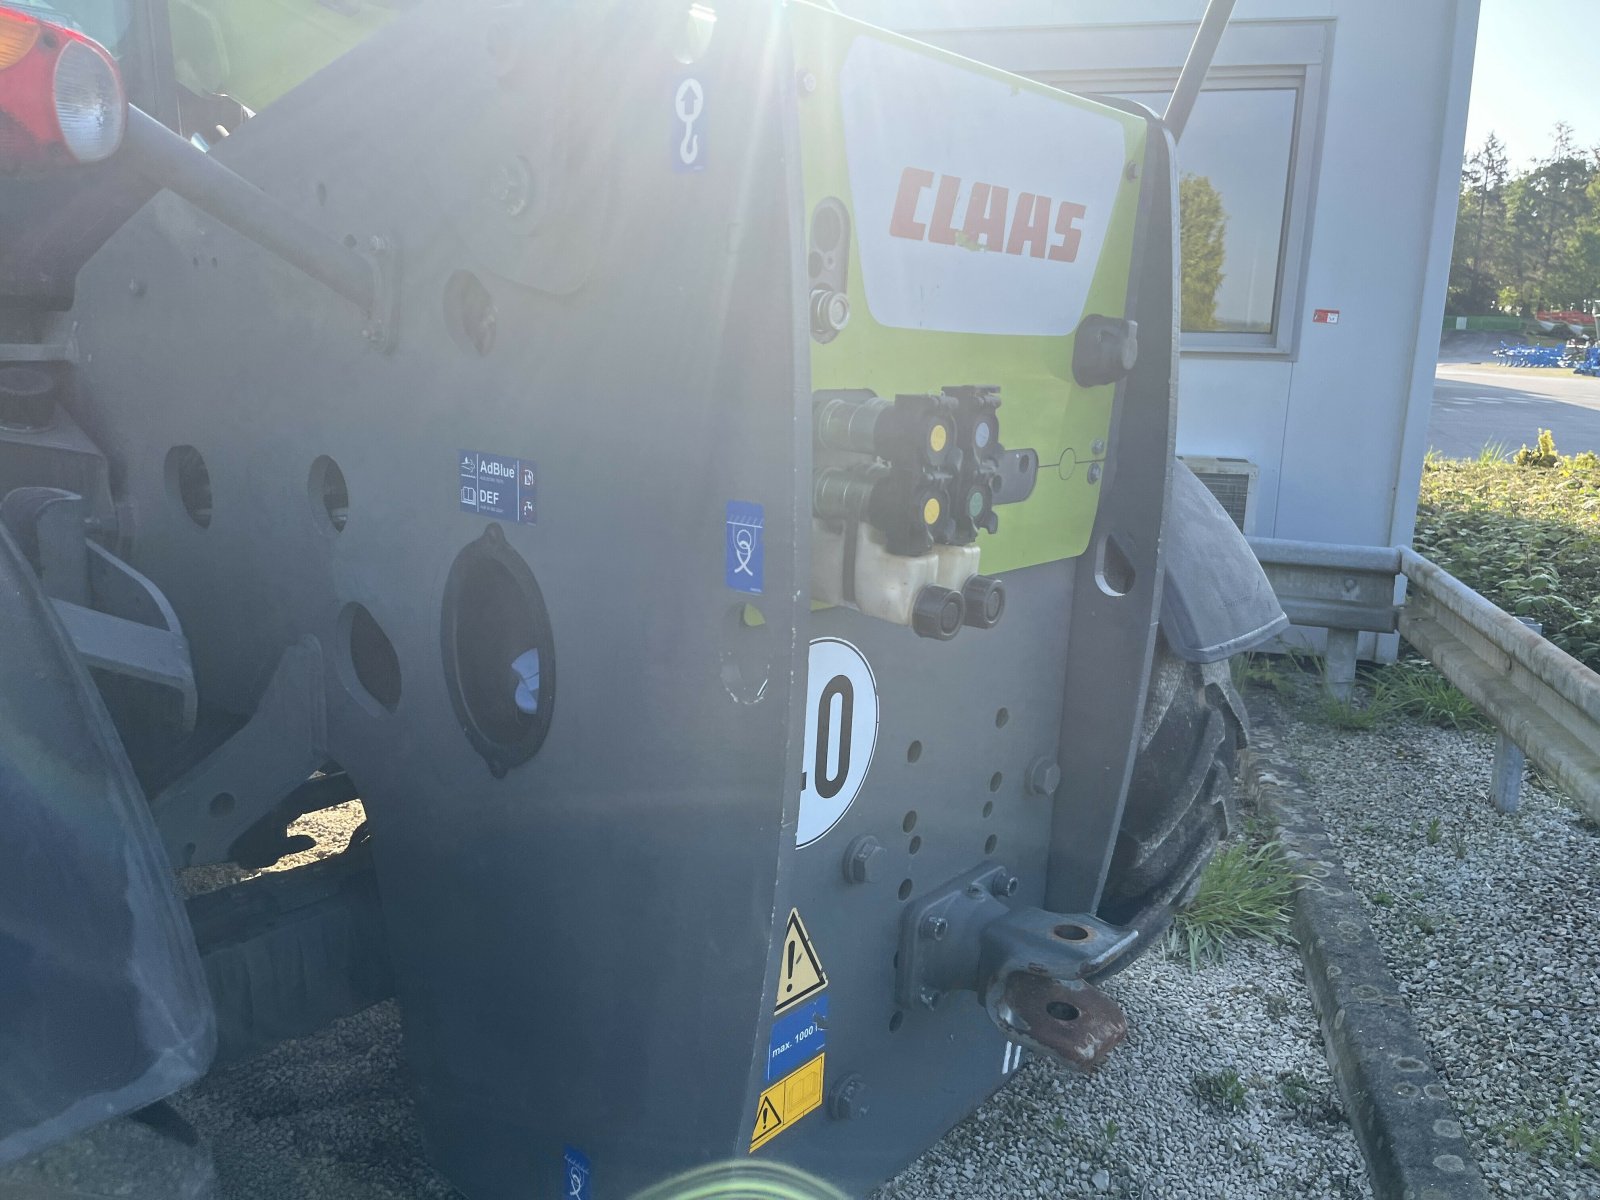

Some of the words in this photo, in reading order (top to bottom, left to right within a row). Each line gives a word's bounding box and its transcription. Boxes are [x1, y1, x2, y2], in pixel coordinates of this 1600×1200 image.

[889, 166, 1087, 263] CLAAS
[480, 460, 515, 478] AdBlue
[479, 489, 500, 505] DEF
[772, 1041, 793, 1058] max.
[794, 1025, 814, 1044] 1000
